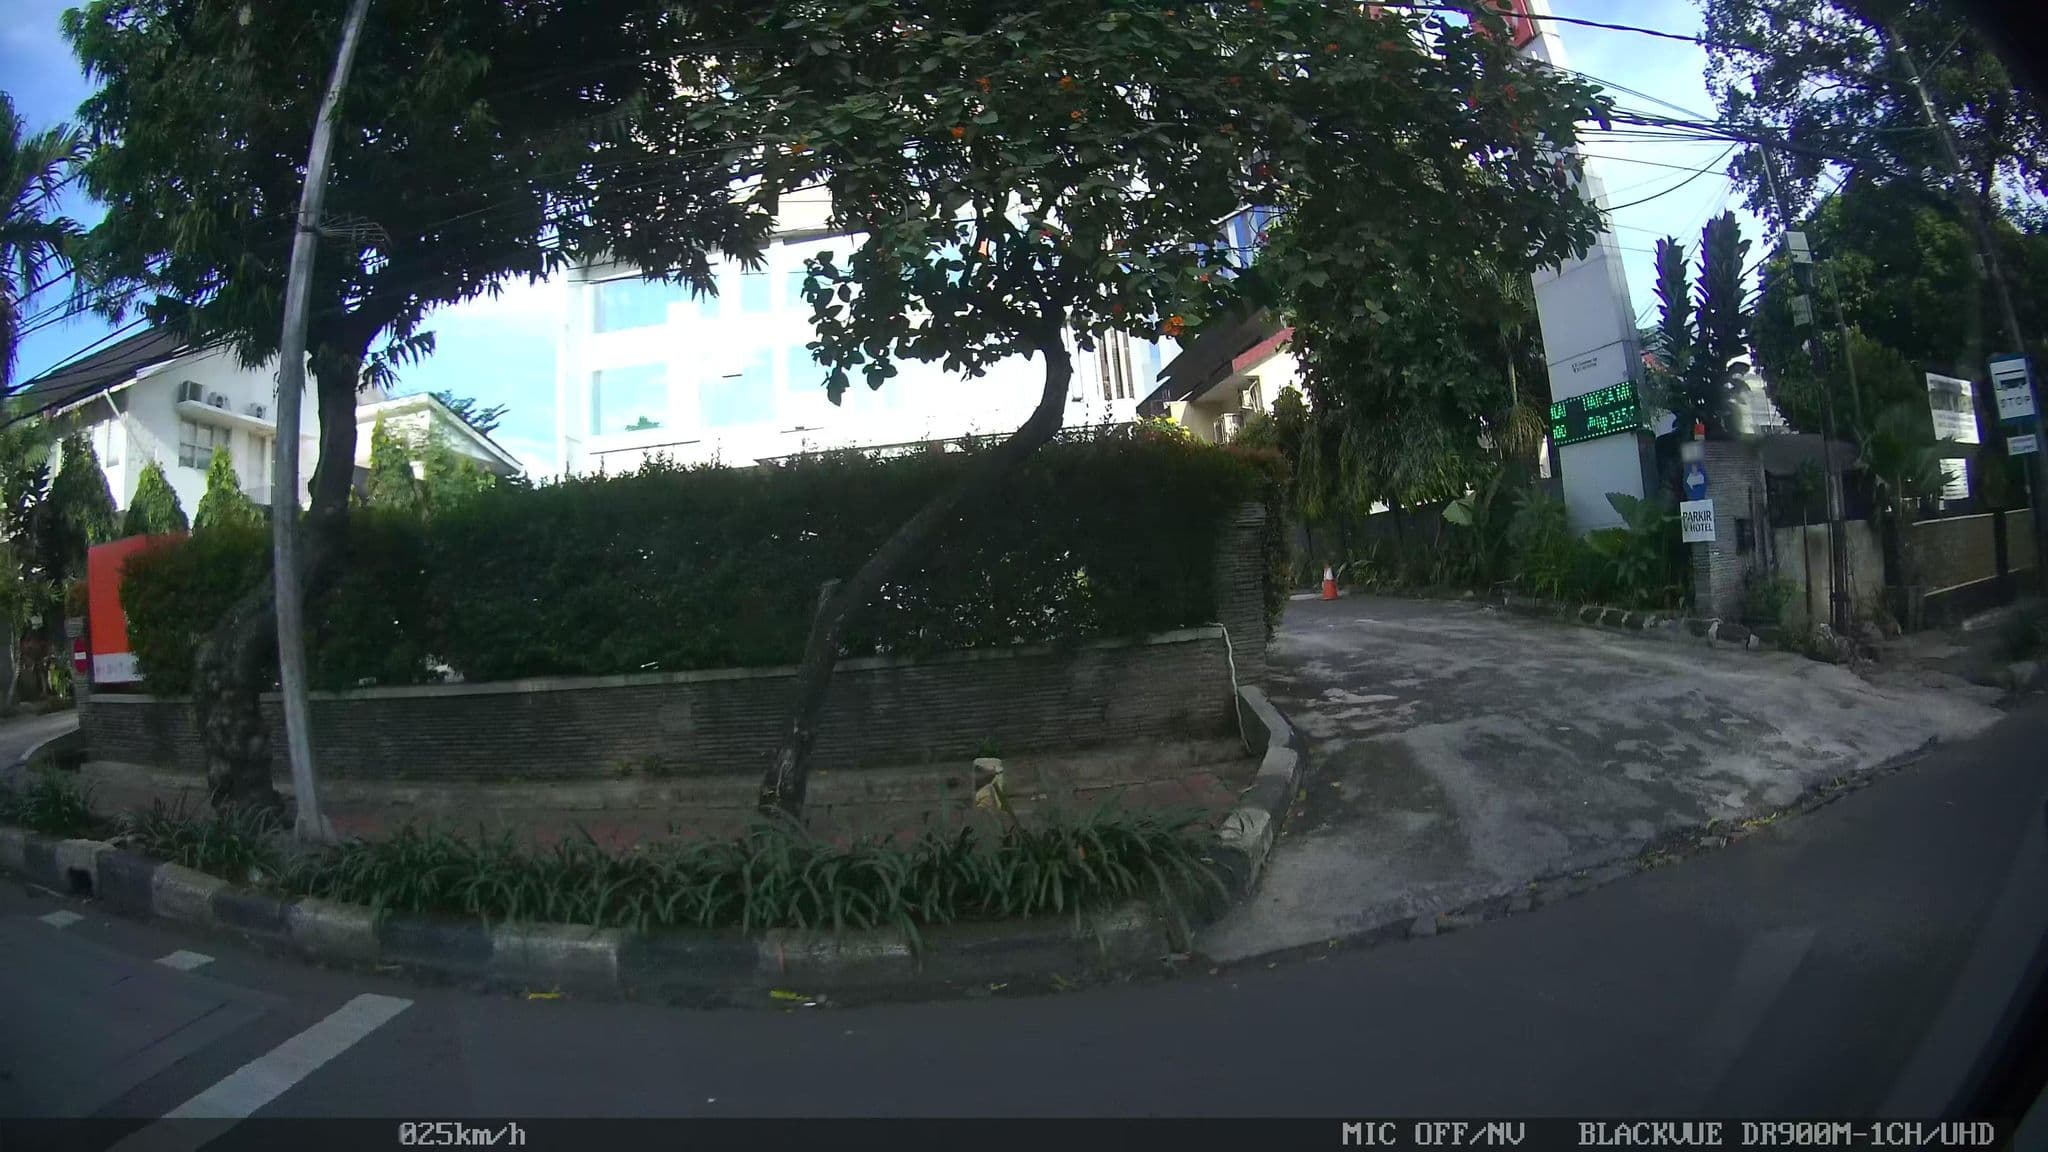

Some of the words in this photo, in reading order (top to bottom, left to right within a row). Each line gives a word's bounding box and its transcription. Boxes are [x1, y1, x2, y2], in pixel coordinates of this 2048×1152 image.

[2001, 395, 2031, 409] STOP
[1682, 510, 1712, 522] PARKIR
[1690, 523, 1713, 533] HOTEL
